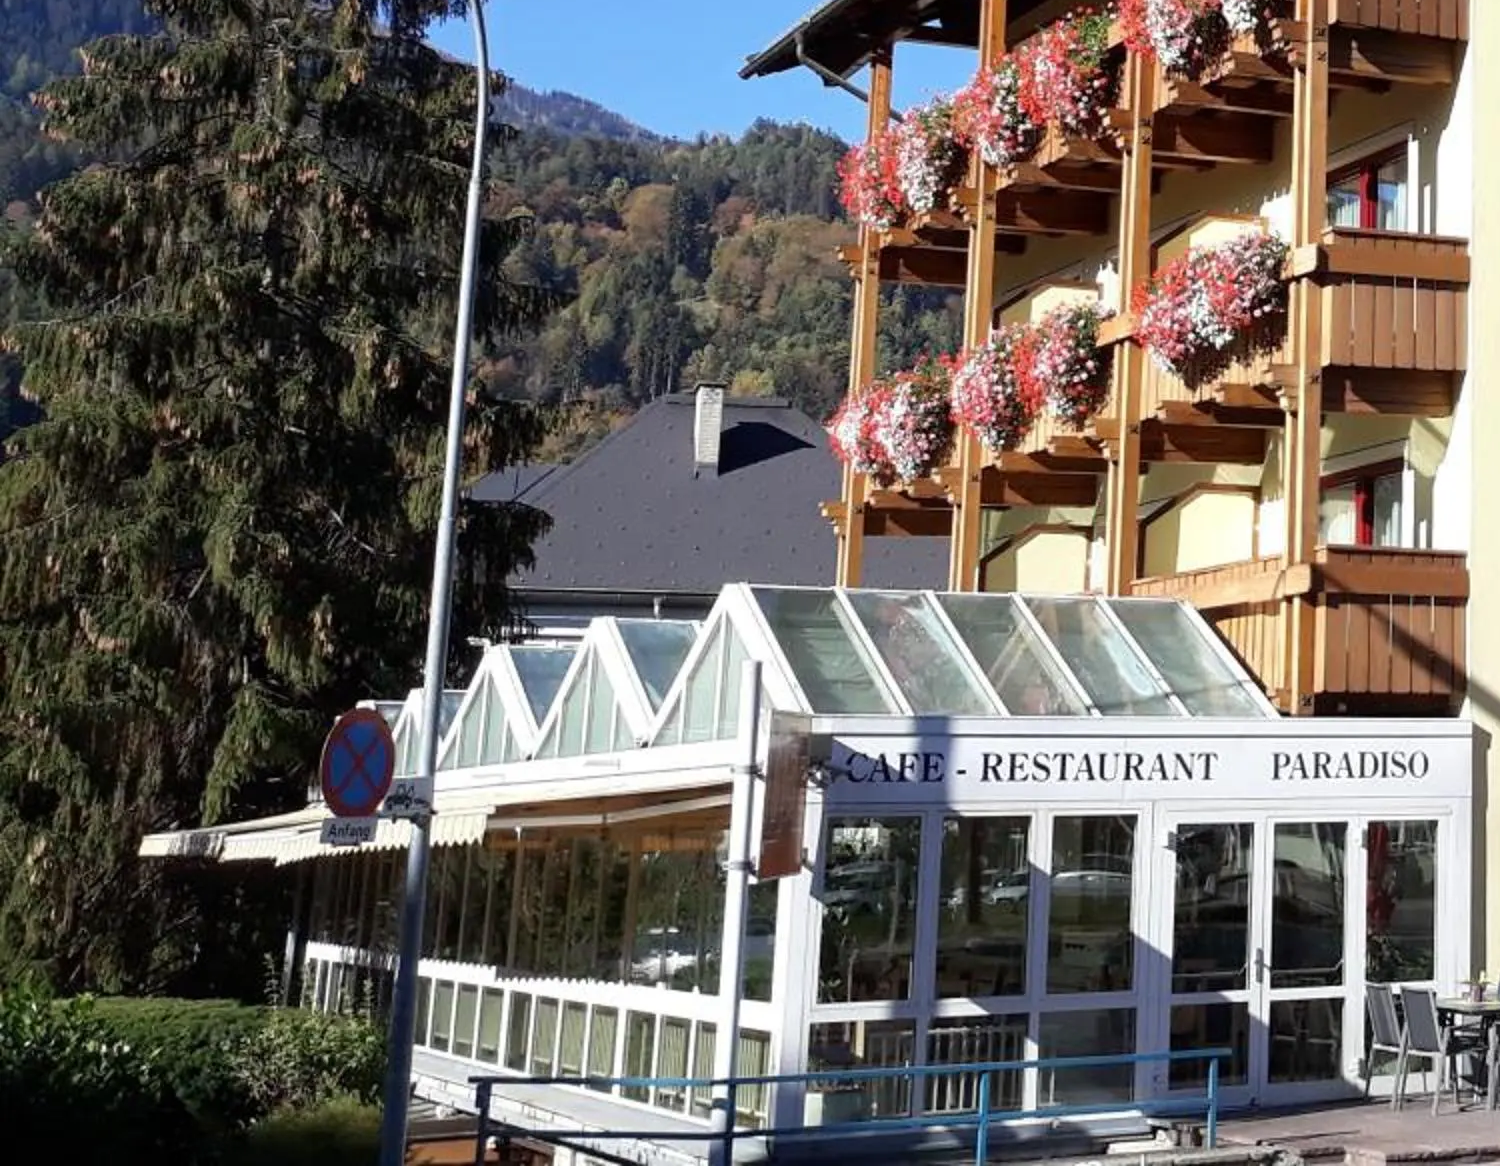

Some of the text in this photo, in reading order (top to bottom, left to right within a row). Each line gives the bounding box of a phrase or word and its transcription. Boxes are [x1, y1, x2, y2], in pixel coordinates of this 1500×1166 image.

[846, 752, 945, 783] CAFE
[980, 751, 1218, 782] RESTAURANT
[1271, 750, 1430, 780] PARADISO
[328, 822, 371, 842] Anfang
